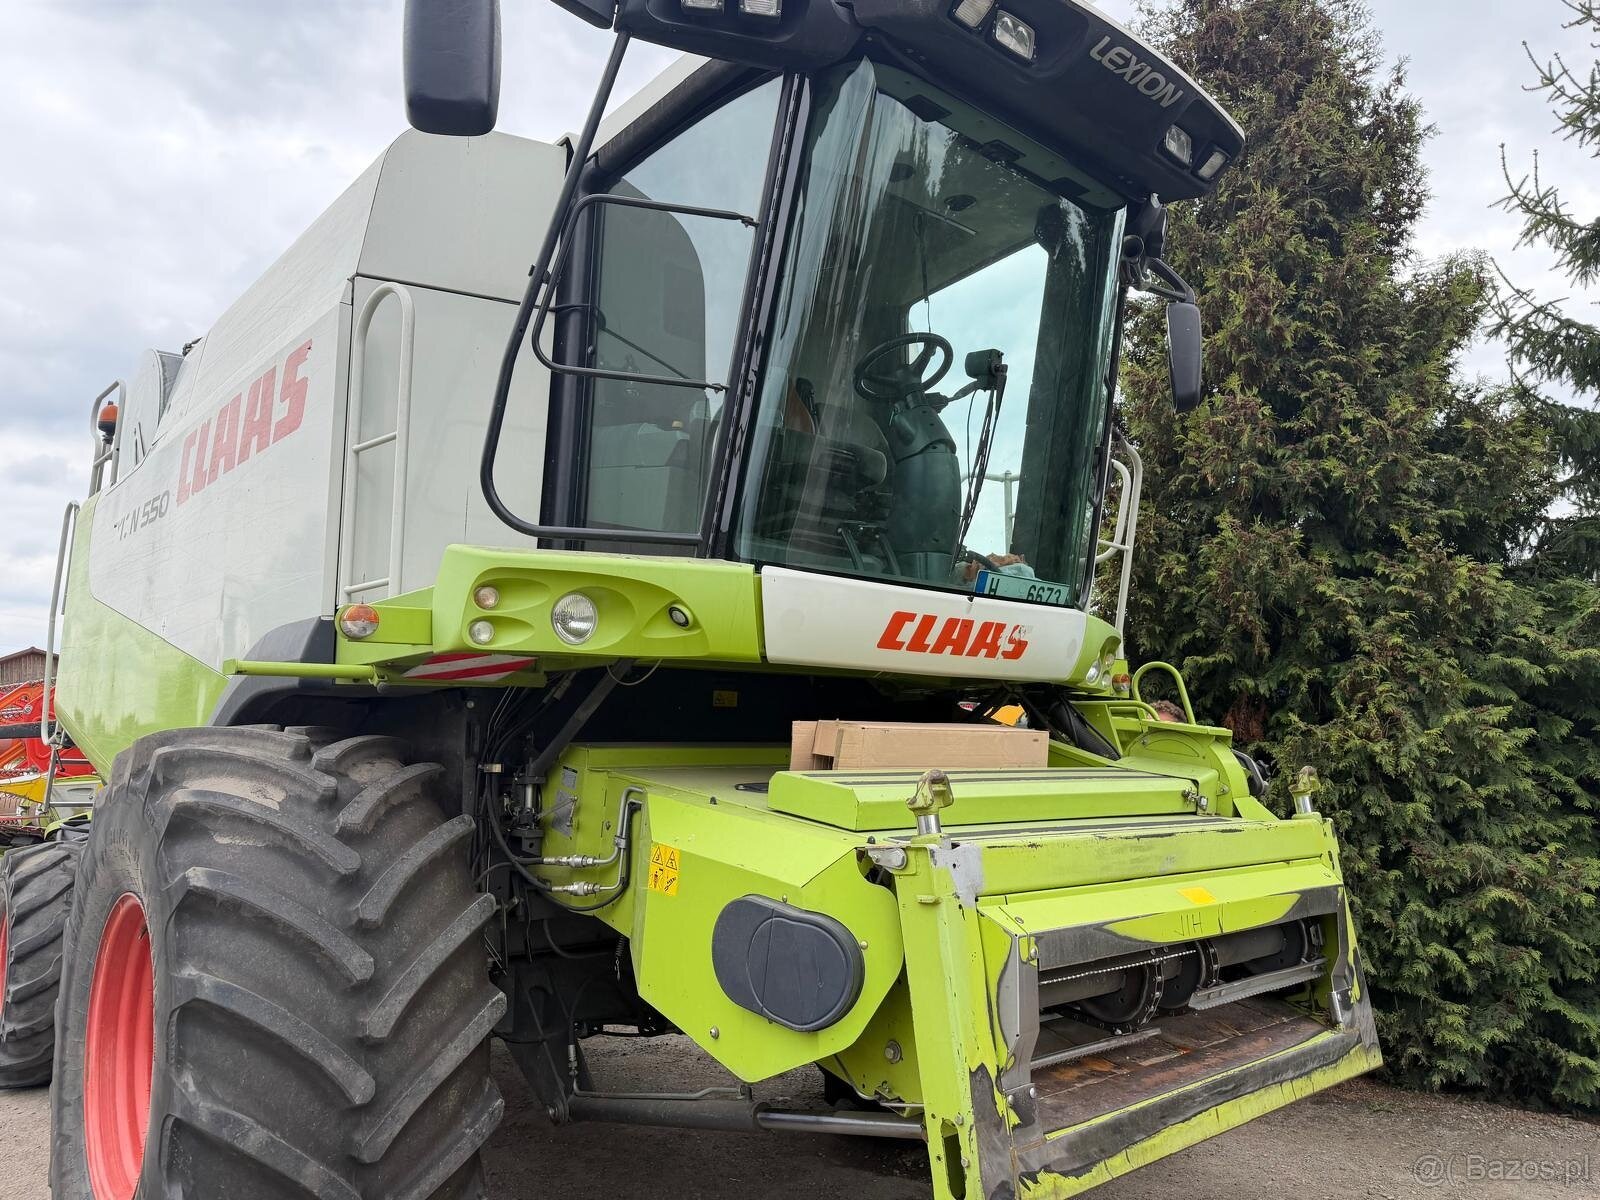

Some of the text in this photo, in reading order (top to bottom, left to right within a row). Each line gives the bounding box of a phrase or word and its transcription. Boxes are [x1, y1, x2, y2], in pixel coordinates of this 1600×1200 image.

[1089, 35, 1184, 108] LEXION
[176, 338, 312, 507] CLAAS
[141, 489, 170, 528] 550
[877, 611, 1028, 660] CLAAS
